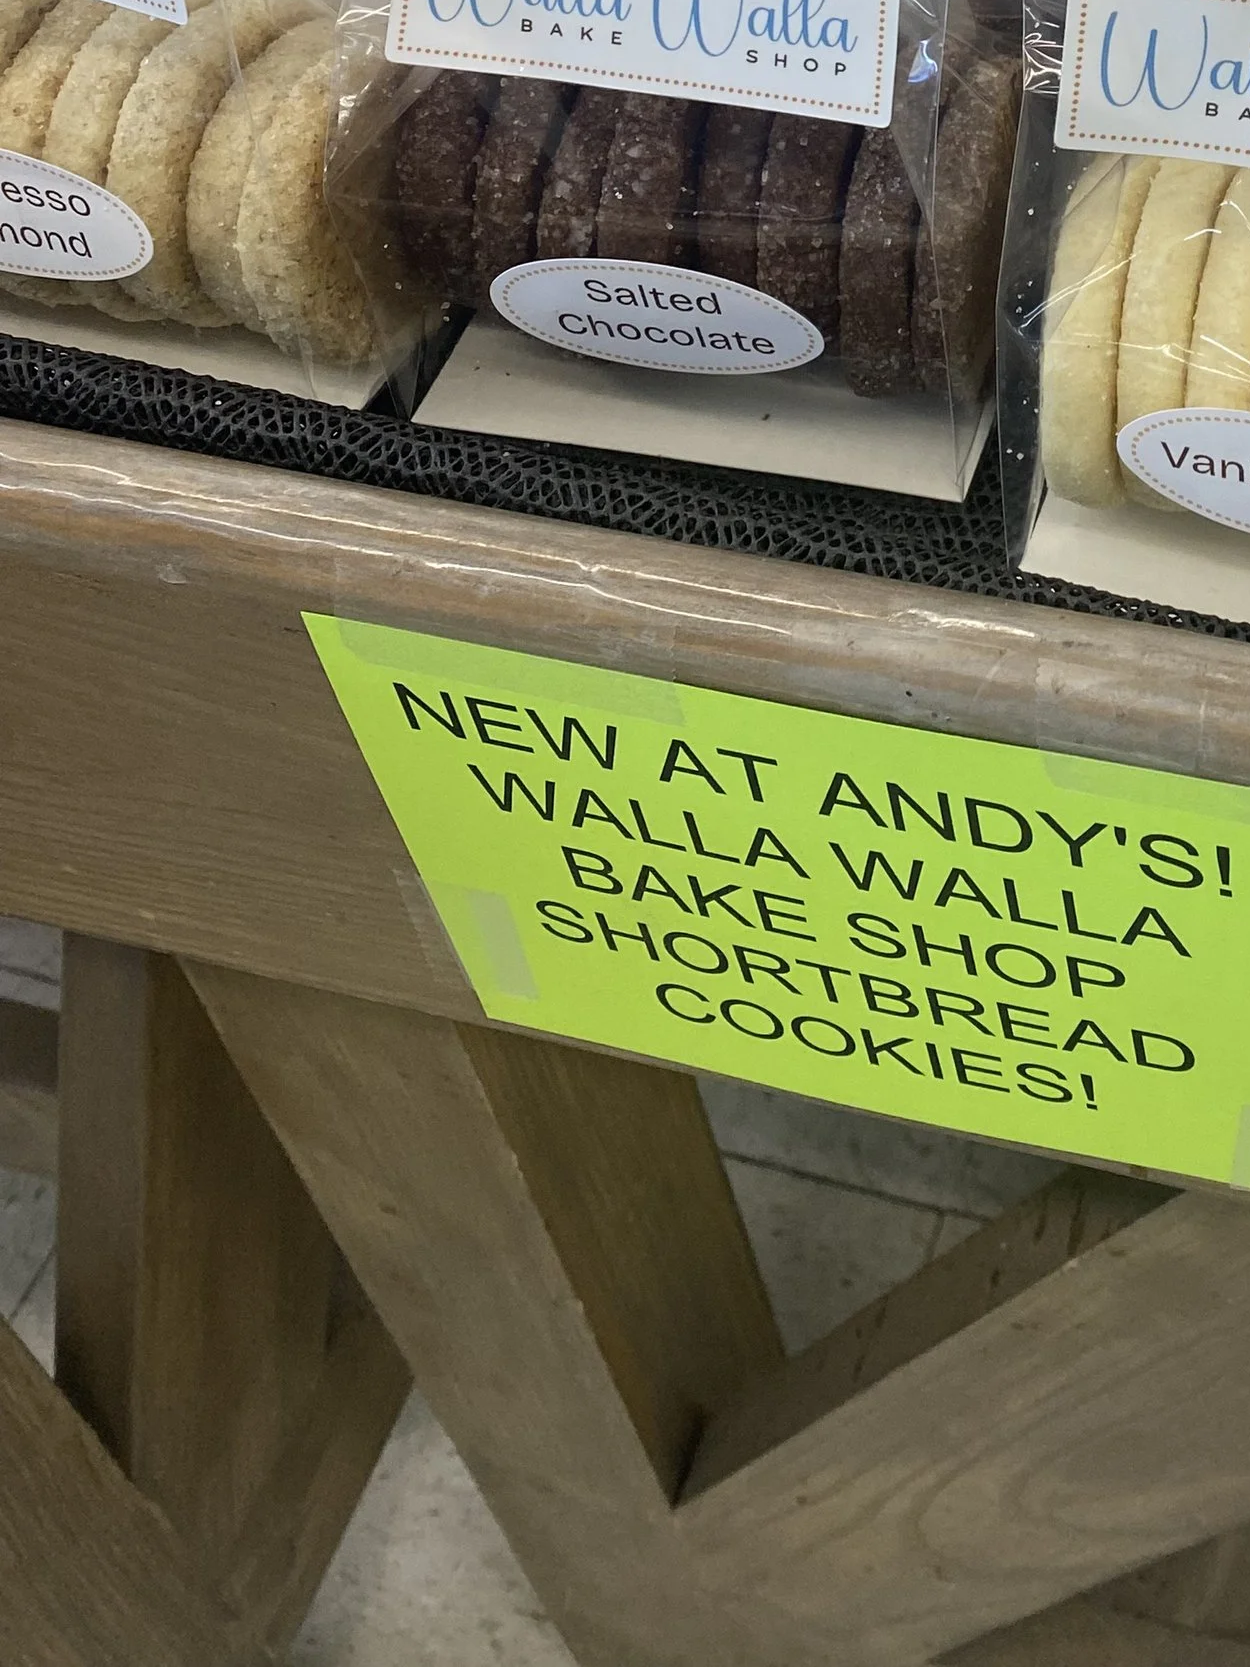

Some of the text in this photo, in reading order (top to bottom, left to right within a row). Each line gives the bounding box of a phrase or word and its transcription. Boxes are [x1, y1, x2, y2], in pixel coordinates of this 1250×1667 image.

[520, 17, 848, 77] BAKE SHOP
[1, 181, 91, 217] esso
[557, 311, 777, 356] Chocolate
[583, 278, 723, 317] Salted
[393, 681, 1234, 898] NEW AT ANDY'S!
[466, 763, 1192, 958] WALLA WALLA
[561, 844, 1129, 999] BAKE SHOP
[535, 899, 1196, 1074] SHORTBREAD
[655, 981, 1099, 1111] COOKIES!
